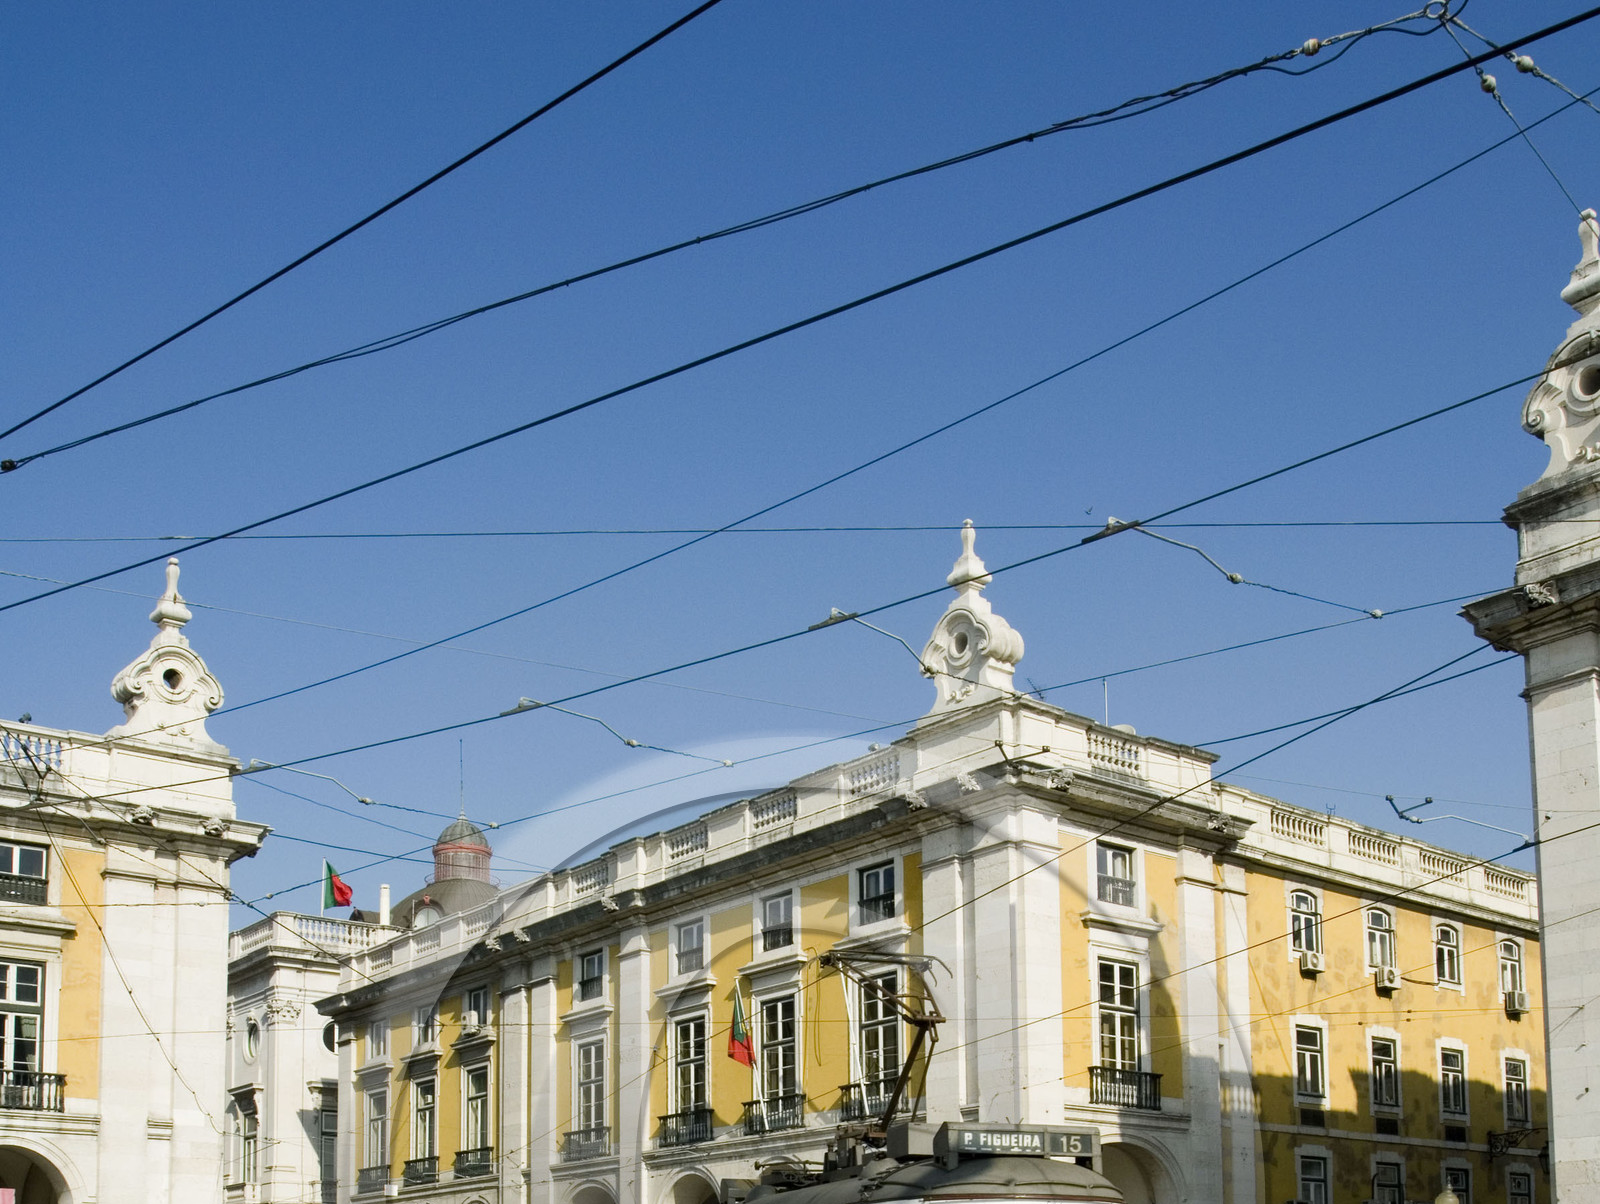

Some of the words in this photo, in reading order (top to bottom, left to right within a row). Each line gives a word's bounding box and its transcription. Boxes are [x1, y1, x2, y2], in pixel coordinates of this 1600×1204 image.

[964, 1132, 973, 1145] P.
[980, 1132, 1041, 1148] FIGUEIRA
[1060, 1135, 1082, 1153] 15
